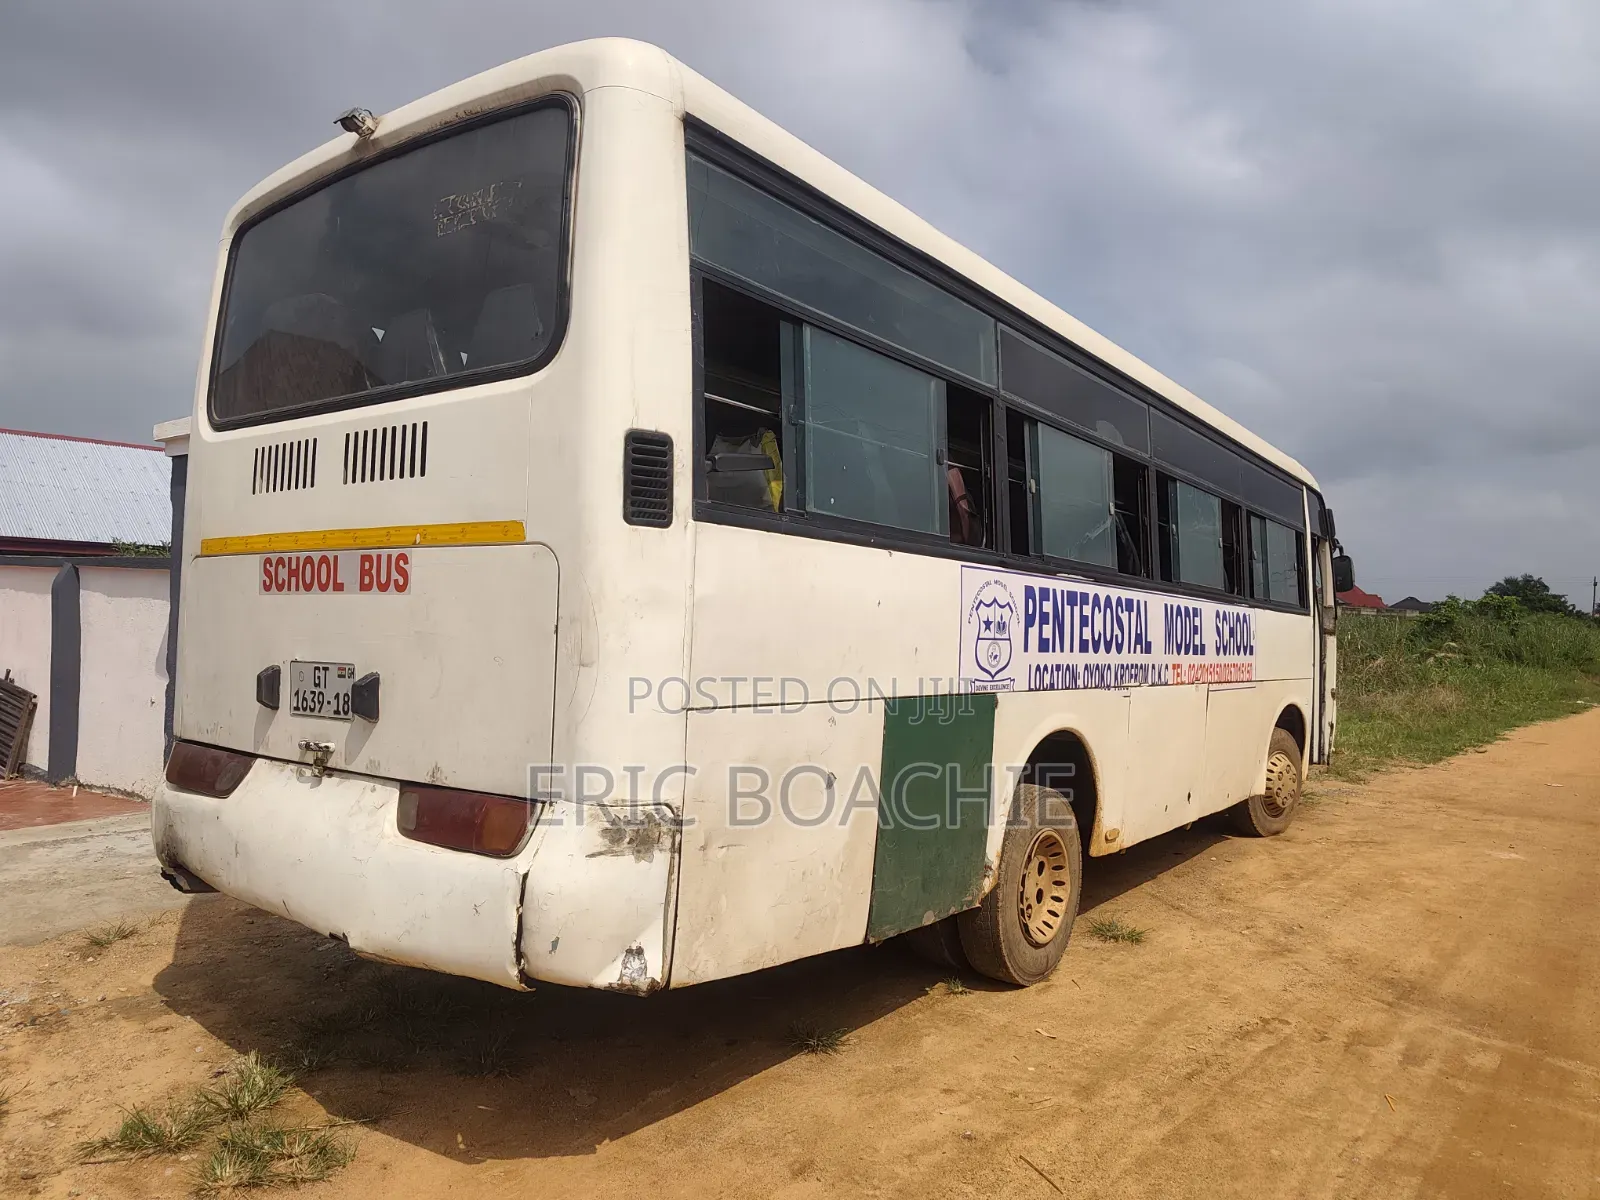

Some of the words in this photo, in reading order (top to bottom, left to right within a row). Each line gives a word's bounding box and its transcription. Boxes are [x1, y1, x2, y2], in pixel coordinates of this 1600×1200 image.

[263, 555, 345, 593] SCHOOL
[359, 552, 410, 593] BUS
[967, 579, 992, 624] PENTECOSTAL
[1023, 585, 1152, 654] PENTECOSTAL
[1163, 603, 1206, 656] MODEL
[1215, 609, 1254, 657] SCHOOL
[313, 666, 330, 689] GT
[1028, 663, 1081, 691] LOCATION:
[1083, 663, 1112, 690] OYOKO
[293, 687, 351, 716] 1639-18
